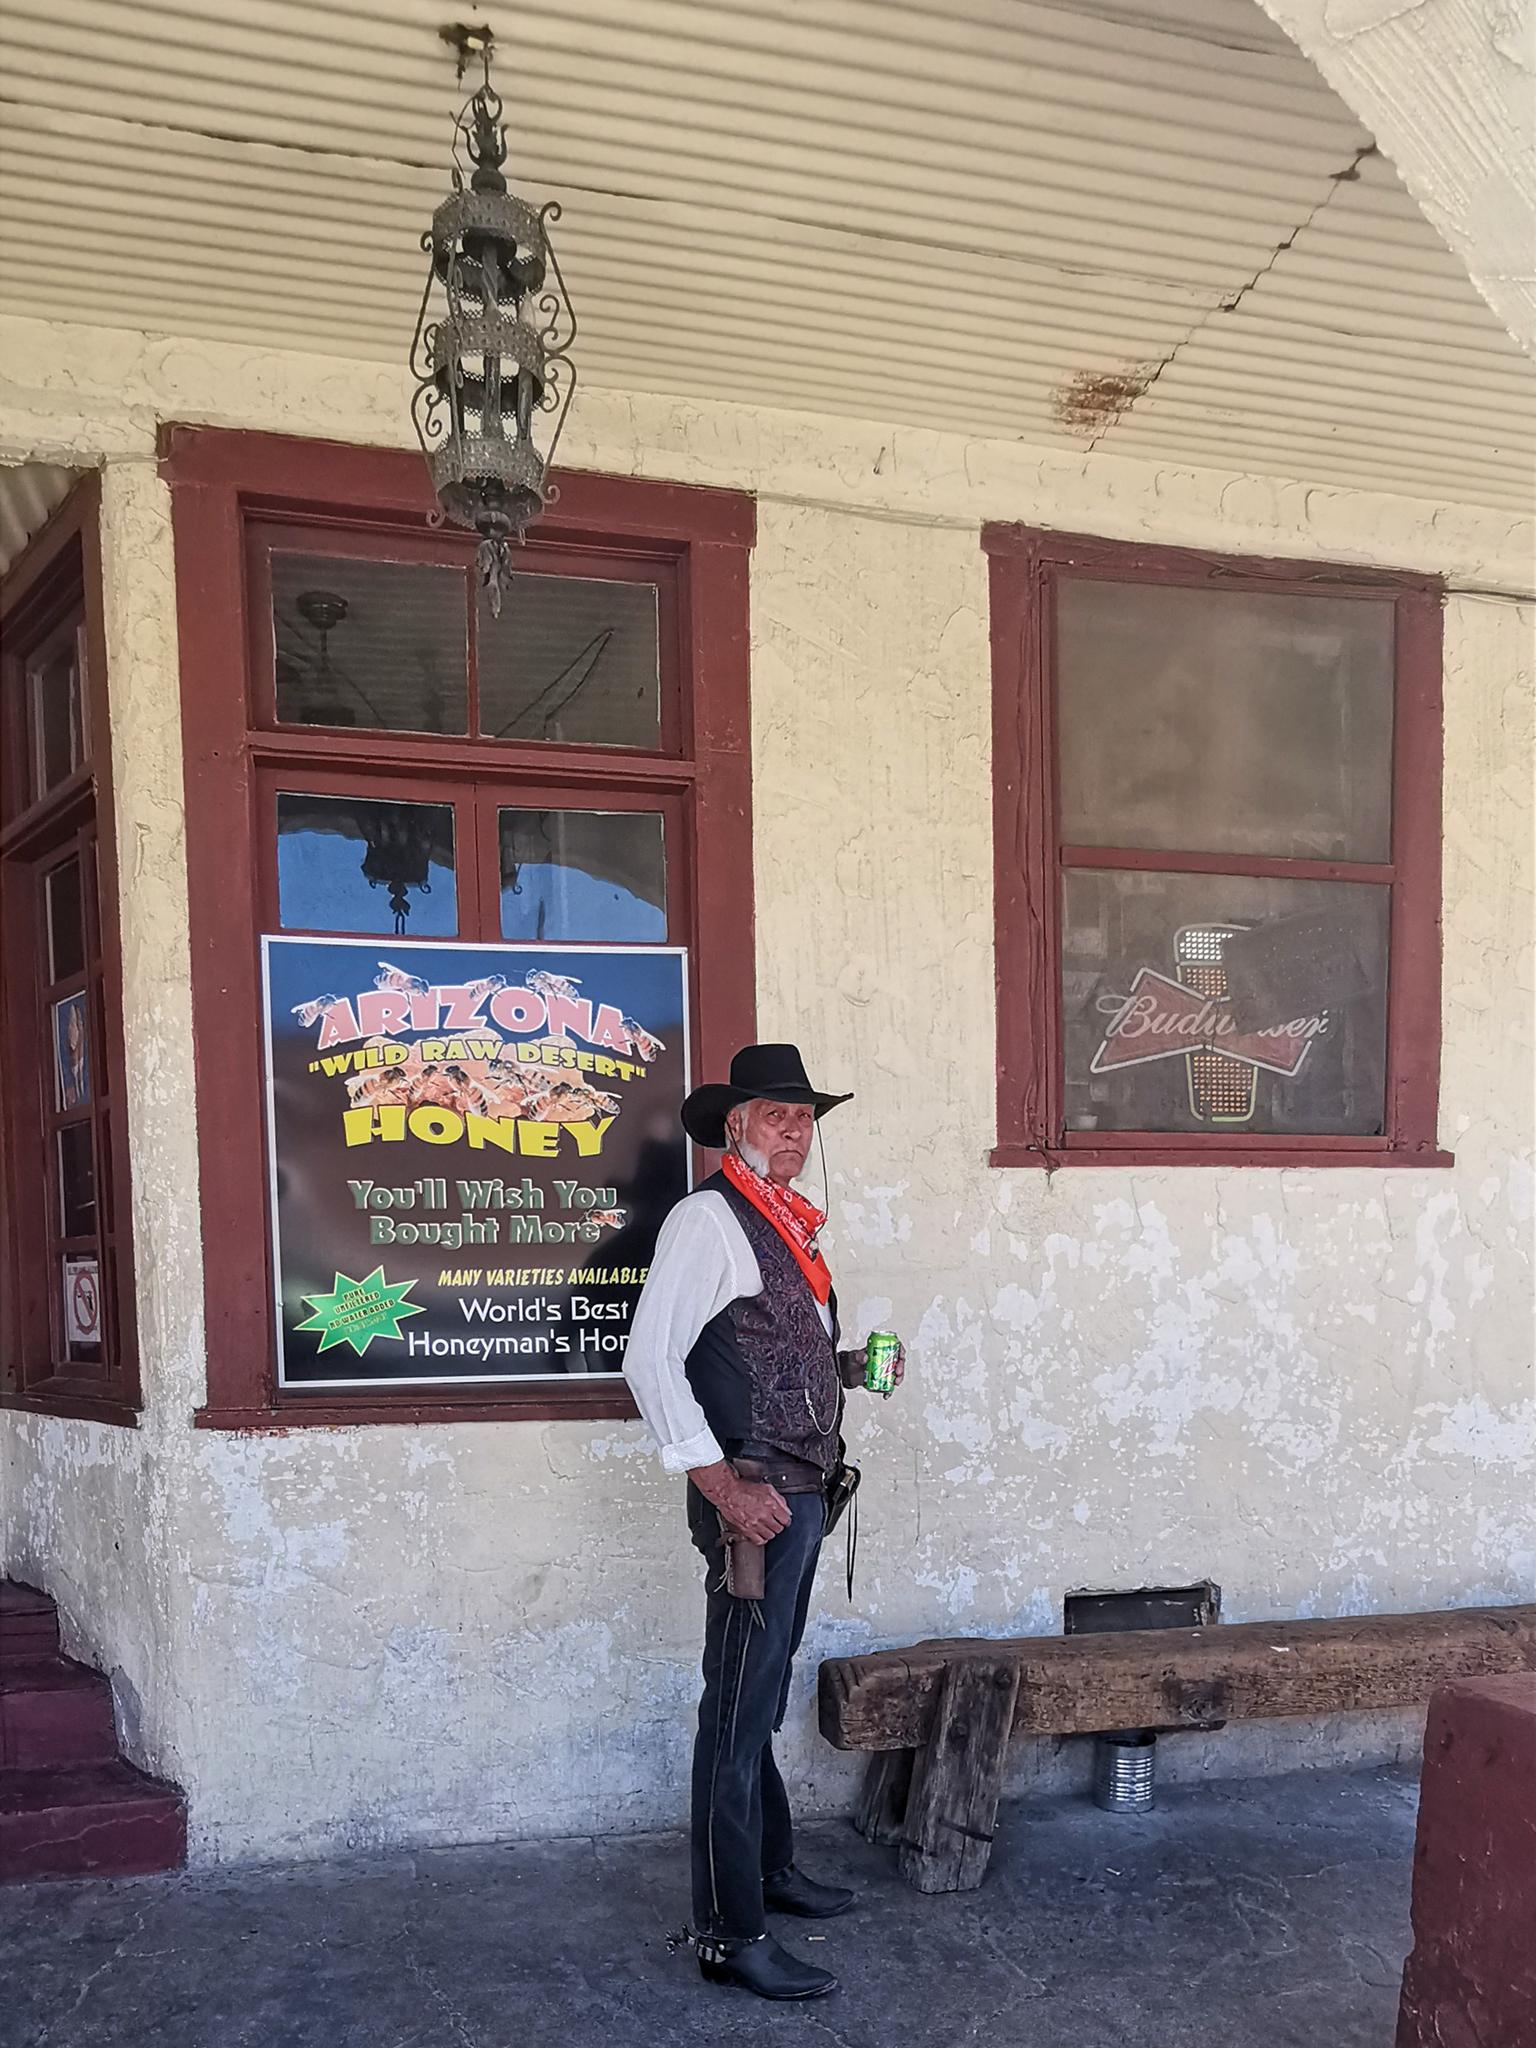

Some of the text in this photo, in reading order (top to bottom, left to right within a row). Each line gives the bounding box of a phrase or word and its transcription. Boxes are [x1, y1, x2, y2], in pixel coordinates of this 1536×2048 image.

[318, 984, 632, 1055] ARIZONA
[309, 1039, 647, 1081] "WILD RAW DESERT"
[343, 1104, 615, 1158] HONEY
[347, 1178, 618, 1211] You'll Wish You
[370, 1213, 601, 1250] Bought More
[437, 1266, 649, 1287] MANY VARIETIES AVAILABLE
[341, 1308, 368, 1325] WATER
[369, 1299, 395, 1314] ADDED
[459, 1296, 629, 1322] World's Best
[408, 1331, 571, 1361] Honeyman's
